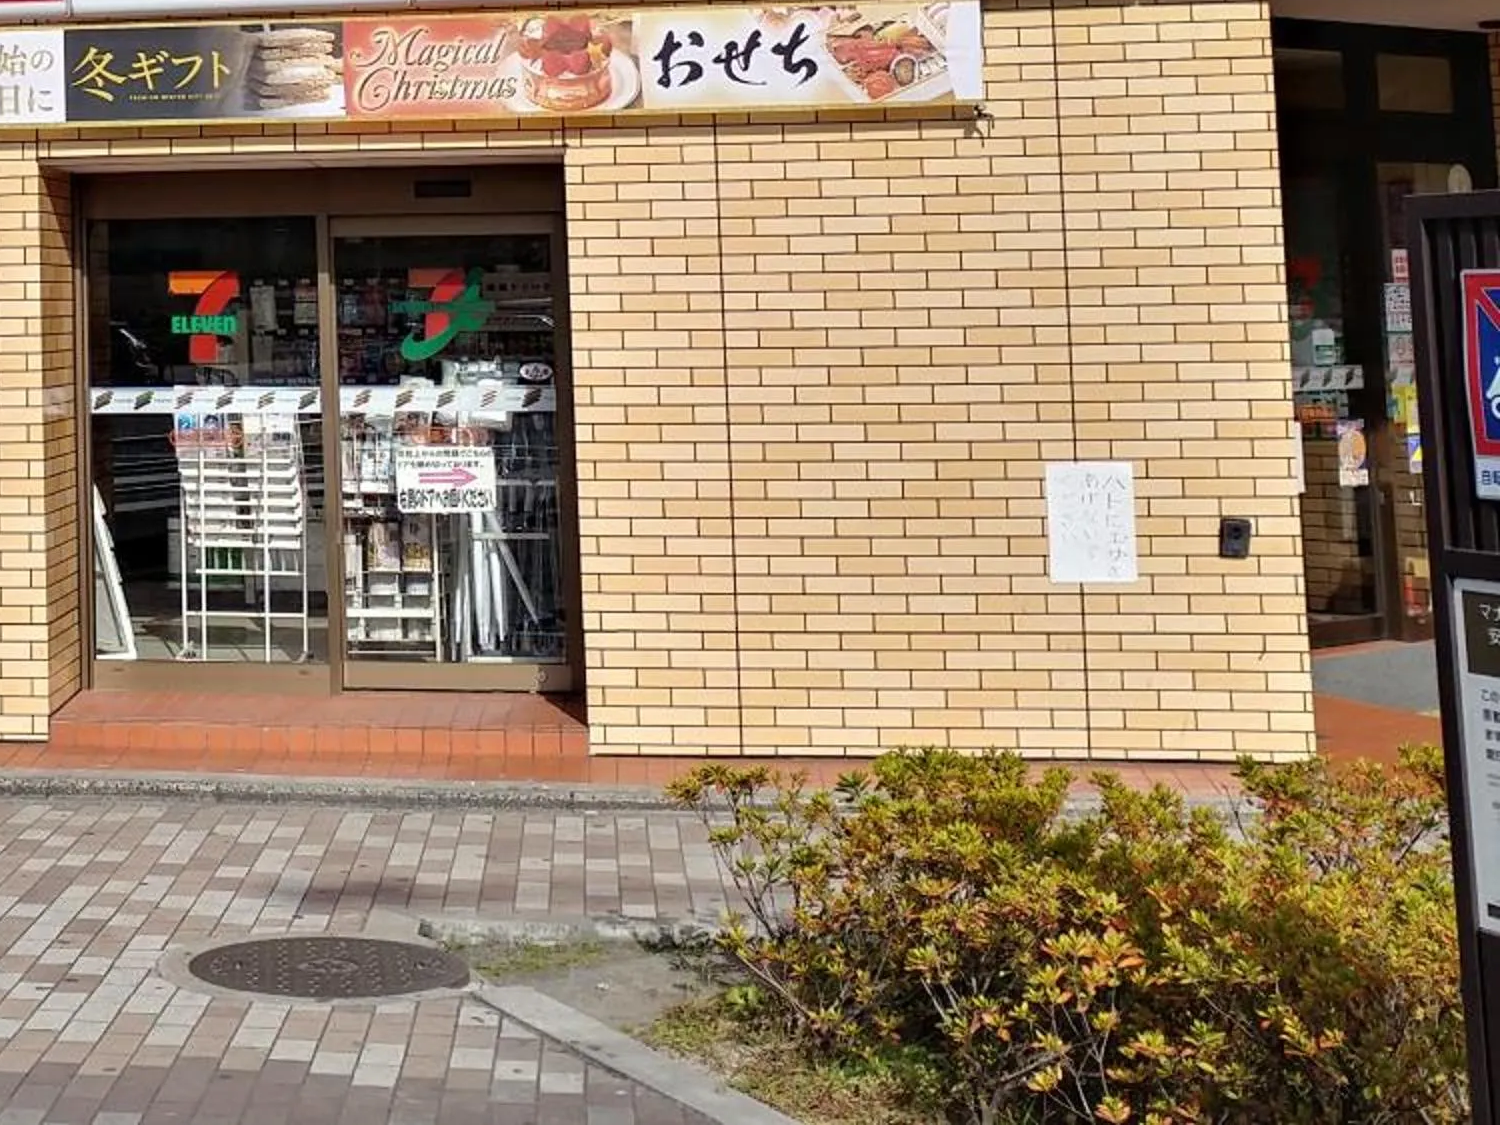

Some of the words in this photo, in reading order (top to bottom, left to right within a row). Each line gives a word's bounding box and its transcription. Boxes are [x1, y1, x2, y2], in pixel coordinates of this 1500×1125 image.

[71, 46, 231, 103] 冬ギフト
[358, 27, 506, 73] Magical
[652, 22, 819, 90] おせち
[356, 70, 518, 112] Christmas
